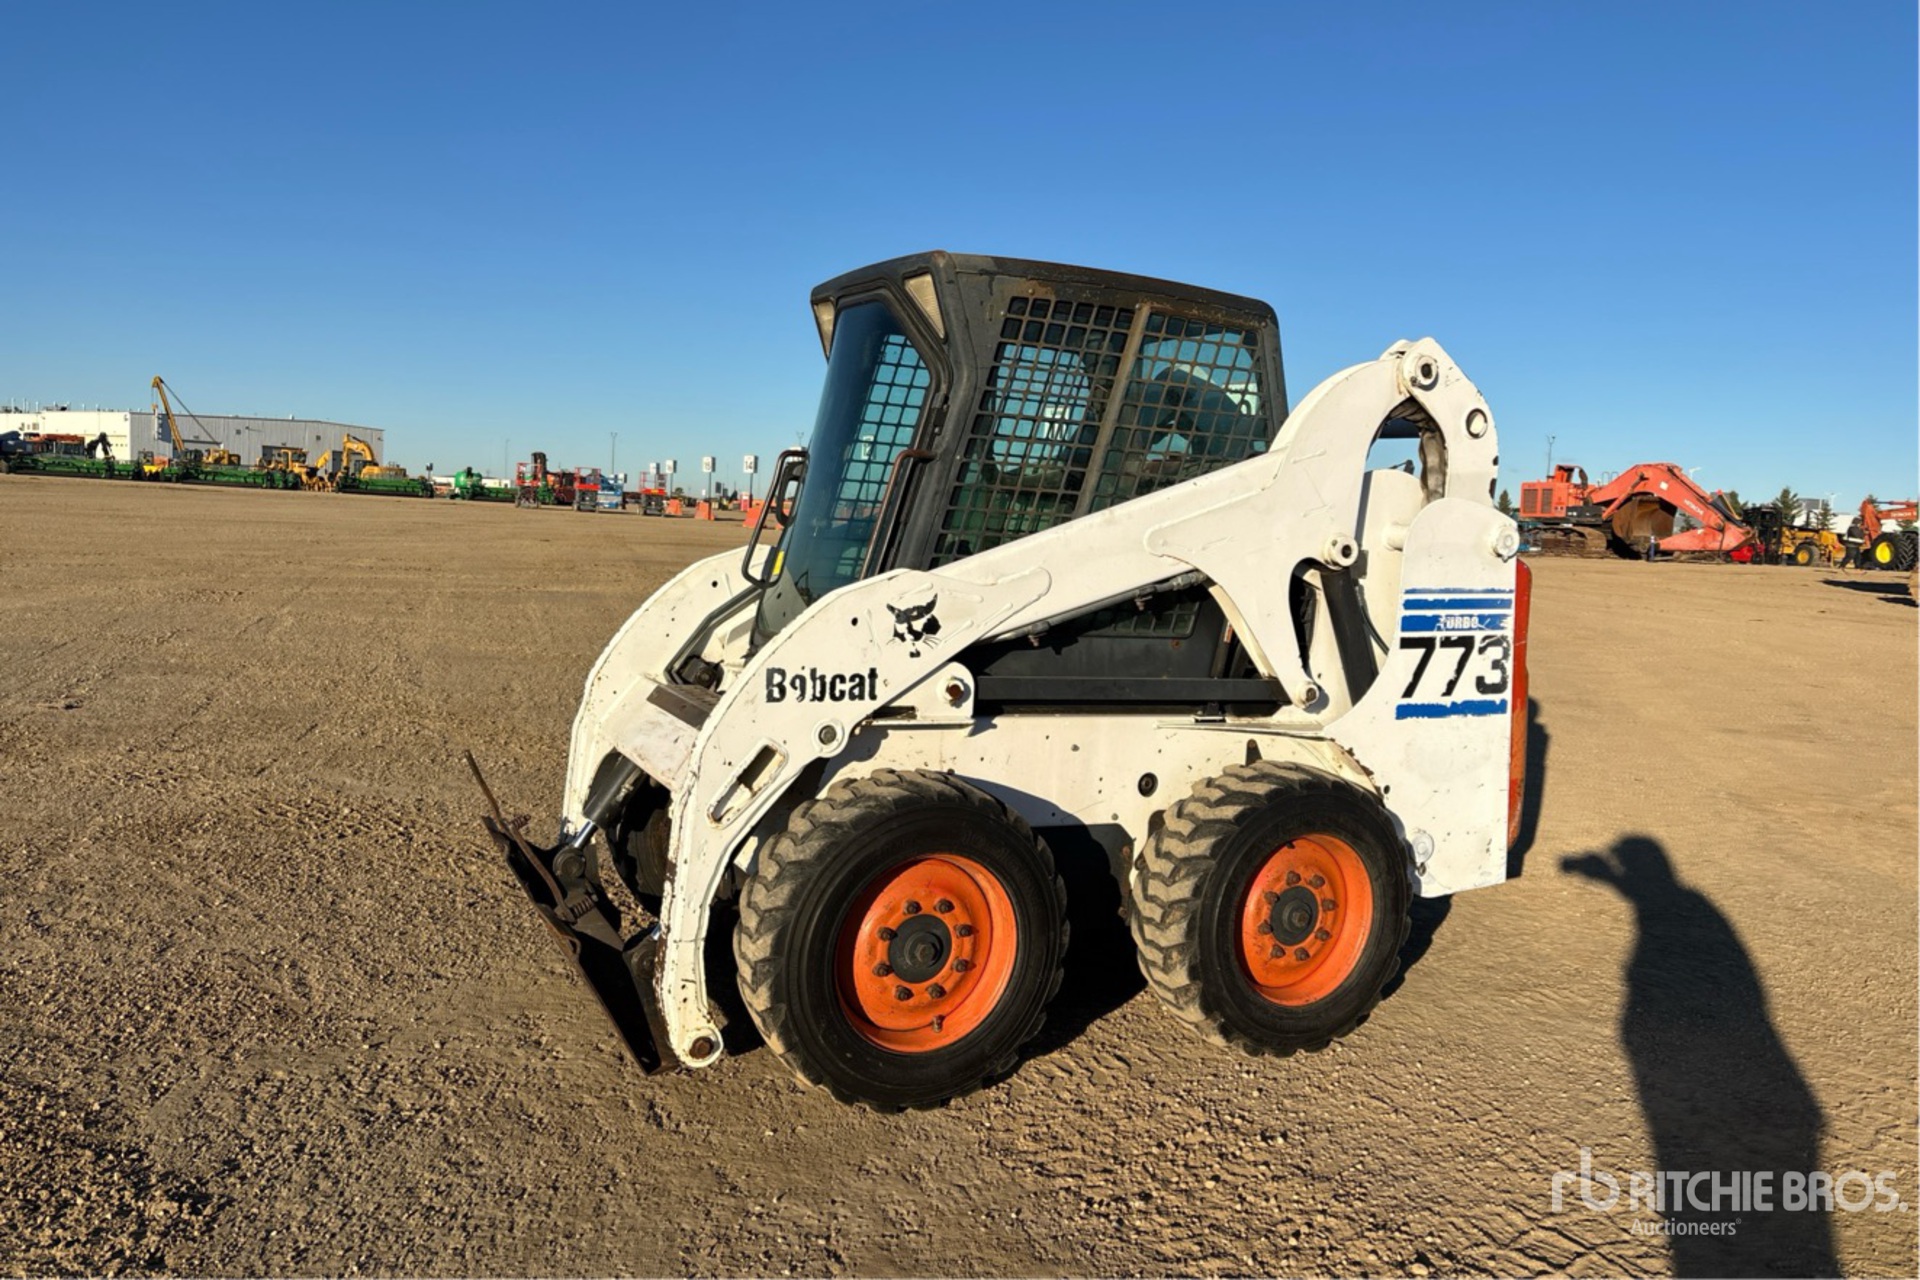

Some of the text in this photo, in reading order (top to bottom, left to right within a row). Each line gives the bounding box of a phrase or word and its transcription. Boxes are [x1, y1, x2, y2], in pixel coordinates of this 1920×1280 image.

[745, 460, 753, 470] 14
[765, 666, 879, 703] Bobcat
[1399, 634, 1511, 698] 773
